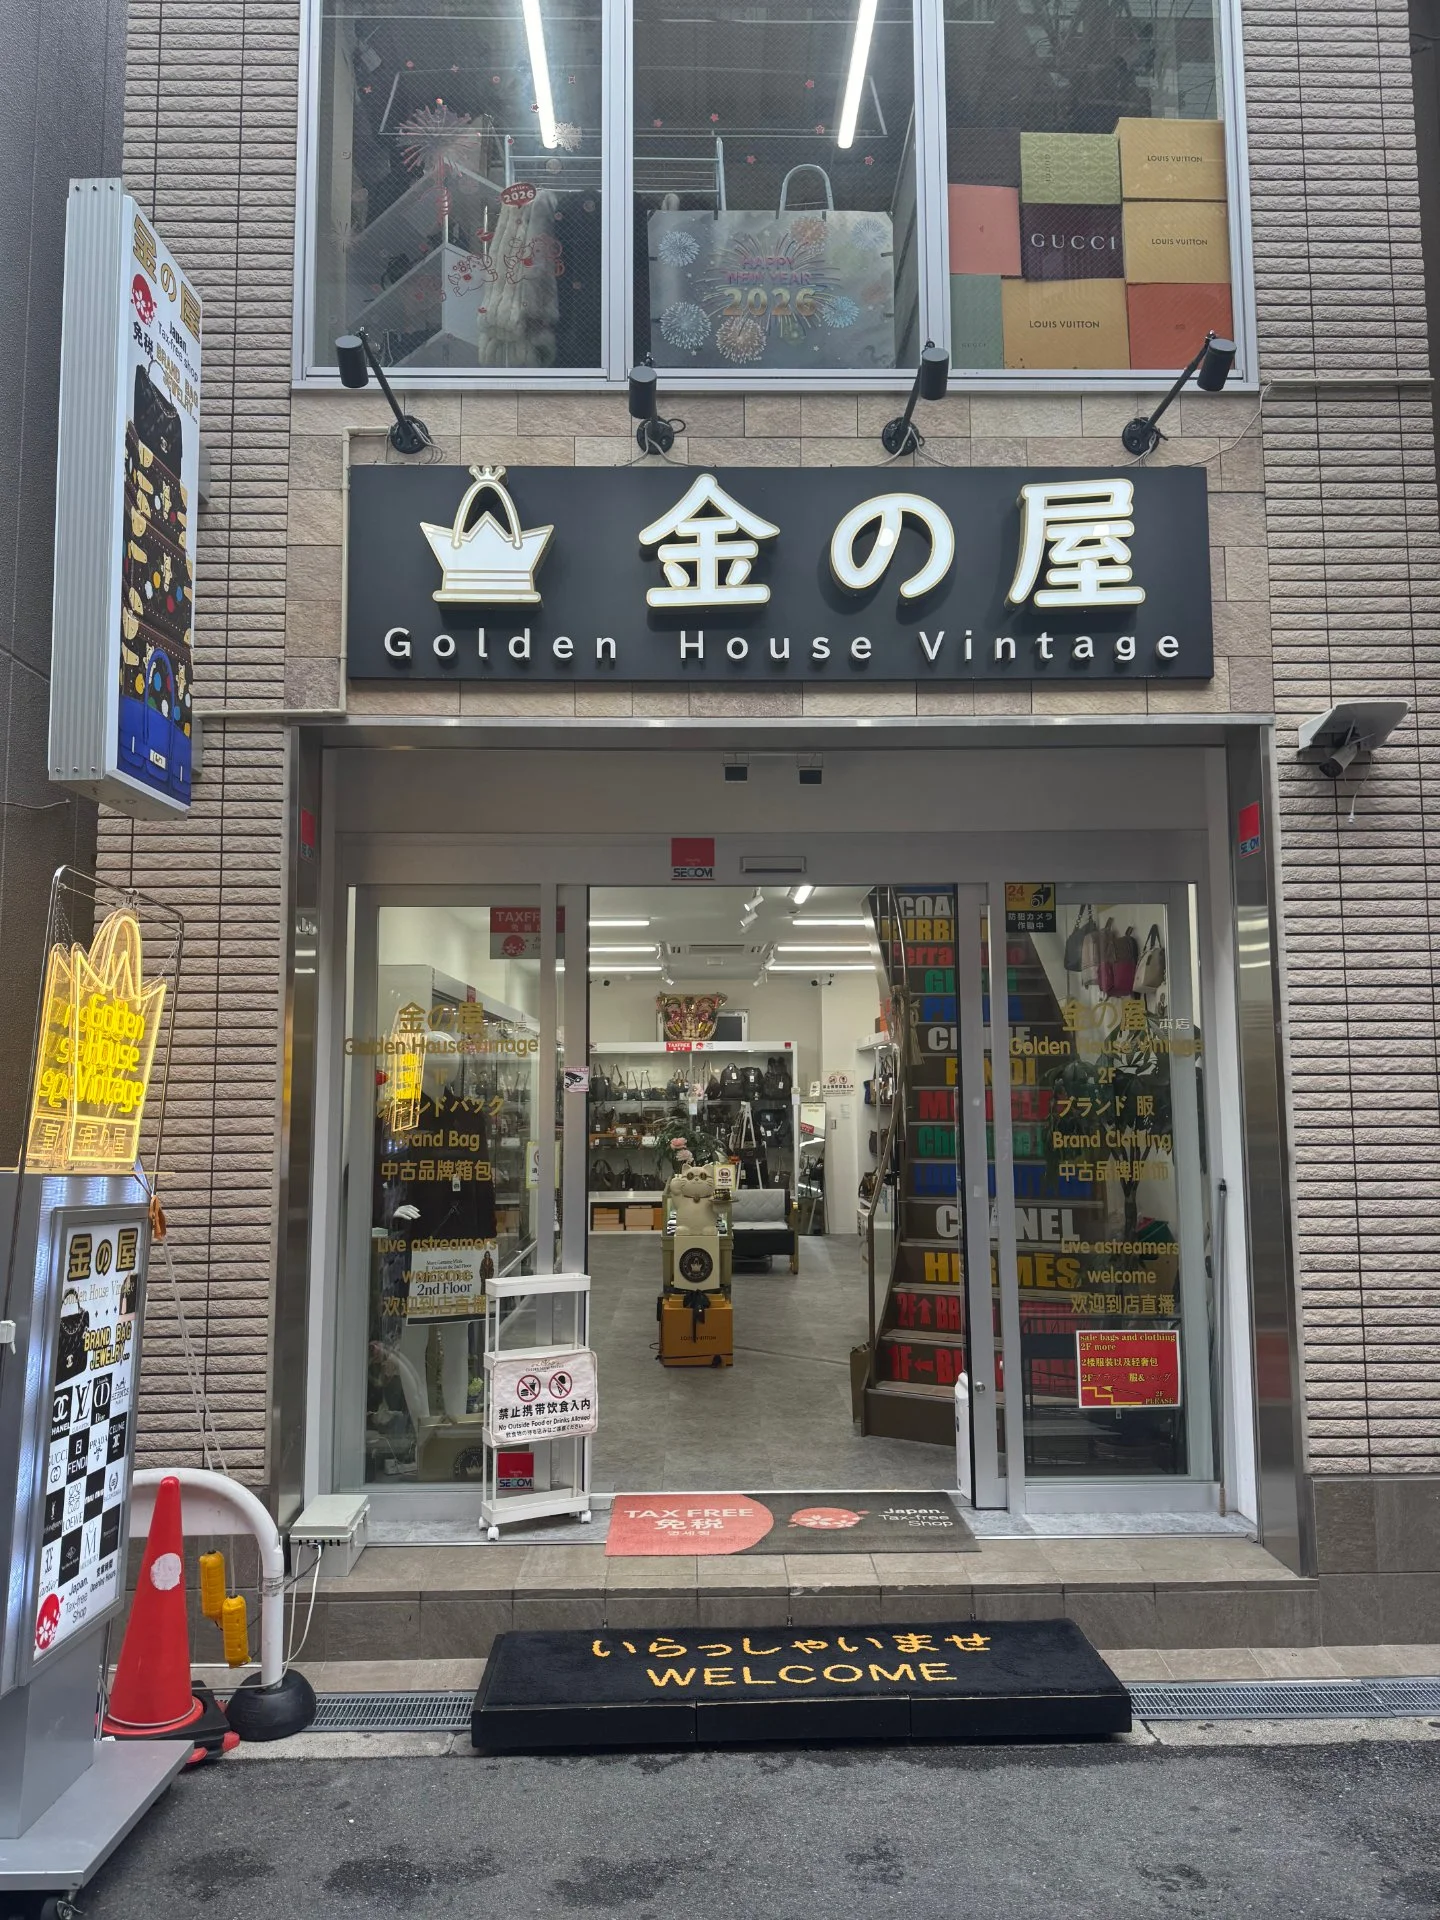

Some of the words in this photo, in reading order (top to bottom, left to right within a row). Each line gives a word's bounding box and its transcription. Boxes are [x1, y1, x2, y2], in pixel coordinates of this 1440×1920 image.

[1171, 155, 1203, 163] VUITTON
[503, 190, 534, 203] 2026
[1030, 233, 1117, 251] GUCCI
[1151, 238, 1174, 246] LOUIS
[1175, 239, 1208, 247] VUITTON
[723, 287, 816, 316] 2026
[1029, 320, 1057, 329] LOUIS
[1060, 320, 1100, 329] VUITTON
[639, 473, 1146, 608] 金の屋
[384, 627, 617, 660] Golden
[680, 630, 872, 660] House
[918, 629, 1180, 662] Vintage
[673, 867, 713, 878] SECOM
[1008, 885, 1024, 897] 24
[398, 1001, 485, 1034] 金の屋
[1063, 1001, 1147, 1032] 金の屋
[1009, 1036, 1071, 1055] Golden
[1097, 1068, 1117, 1084] 2F
[1057, 1095, 1128, 1117] ブランド
[396, 1132, 444, 1150] Brand
[449, 1131, 481, 1151] Bag
[1052, 1131, 1100, 1149] Brand
[1105, 1131, 1173, 1152] Clothing
[381, 1160, 493, 1182] 中古品牌箱包
[67, 1228, 138, 1282] 金の屋
[1088, 1266, 1157, 1284] welcome
[417, 1283, 440, 1296] 2nd
[443, 1282, 473, 1294] Floor
[1071, 1294, 1176, 1315] 欢迎到店直播
[84, 1325, 111, 1352] BRAND
[116, 1320, 132, 1345] BAG
[1100, 1333, 1119, 1342] bags
[1122, 1333, 1137, 1341] and
[1140, 1333, 1176, 1342] clothing
[1080, 1343, 1092, 1351] 2F
[498, 1398, 591, 1420] 禁止携带饮食入内
[51, 1422, 71, 1436] HANEL
[508, 1421, 530, 1430] Outside
[531, 1419, 546, 1427] Food
[570, 1414, 591, 1422] Allowed
[68, 1455, 88, 1475] FENDI
[499, 1478, 532, 1488] SECOM
[624, 1510, 680, 1518] TAX
[687, 1508, 754, 1518] FREE
[884, 1507, 946, 1515] Japan.
[654, 1518, 724, 1530] 免税
[908, 1520, 954, 1528] Shop
[72, 1606, 87, 1623] Shop
[592, 1632, 992, 1658] いらっしゃいませ
[646, 1662, 958, 1687] WELCOME
